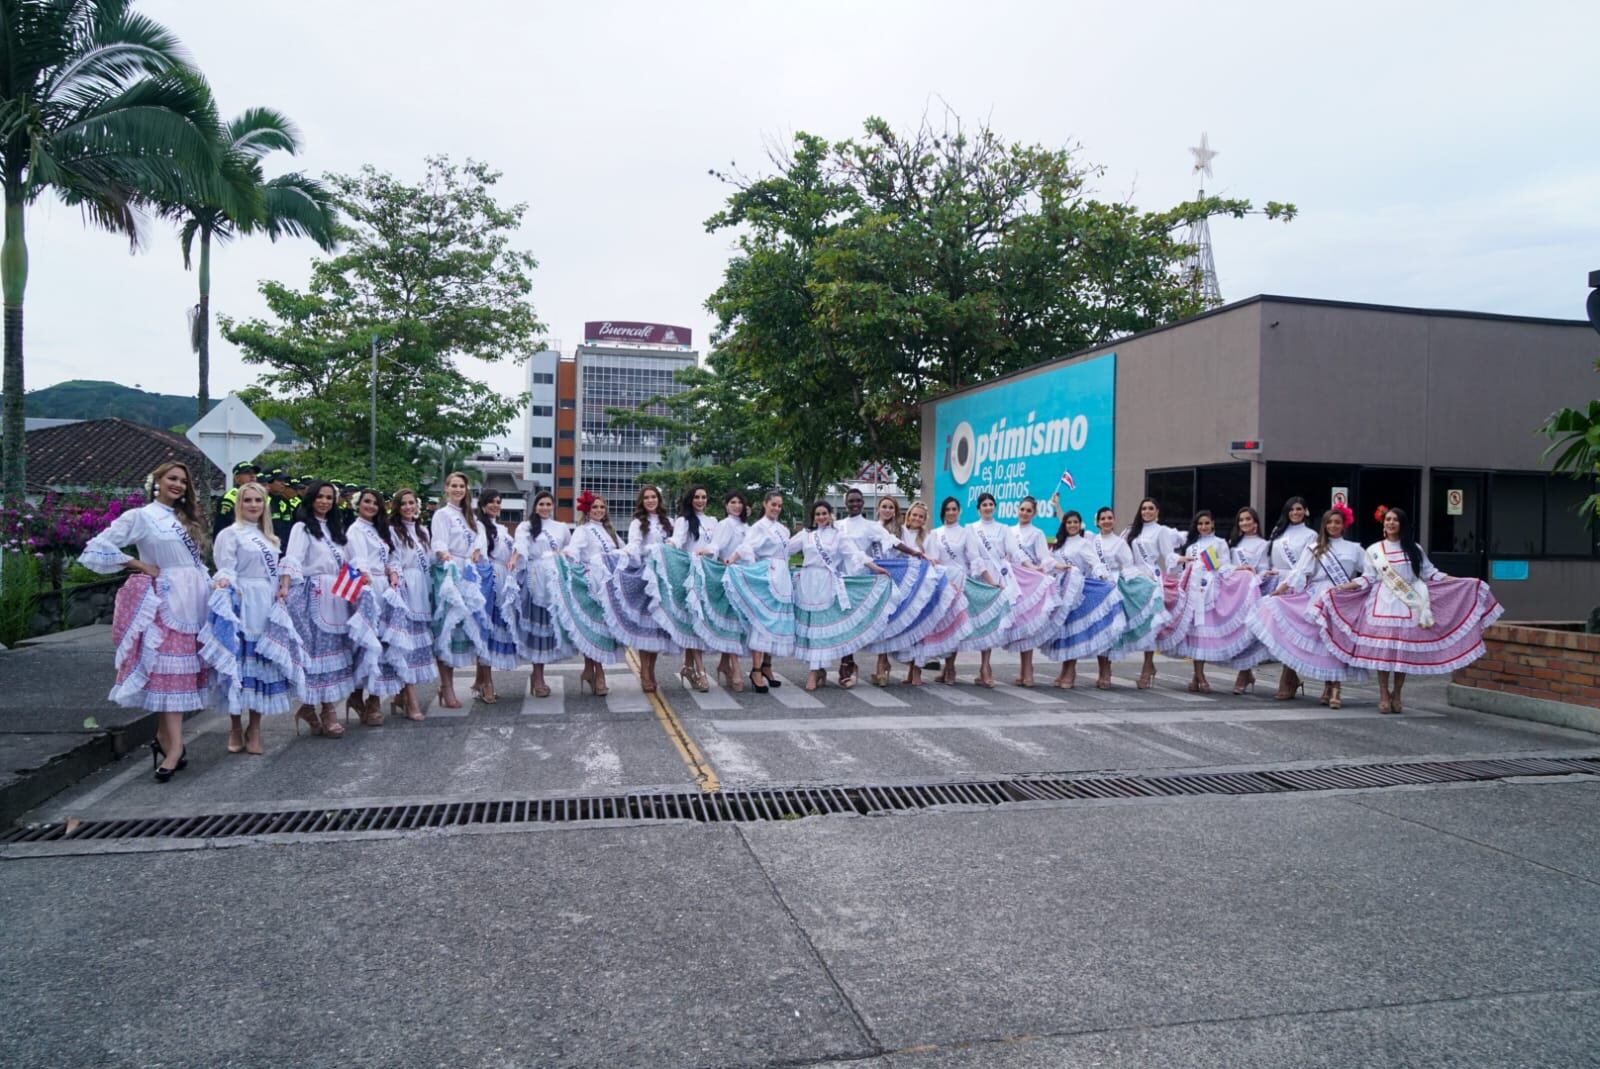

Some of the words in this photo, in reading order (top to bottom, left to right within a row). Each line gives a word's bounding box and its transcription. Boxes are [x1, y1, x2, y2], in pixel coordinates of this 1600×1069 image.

[982, 465, 993, 481] es
[994, 459, 1004, 480] lo
[1006, 461, 1026, 484] que
[251, 537, 277, 577] URUGUAY
